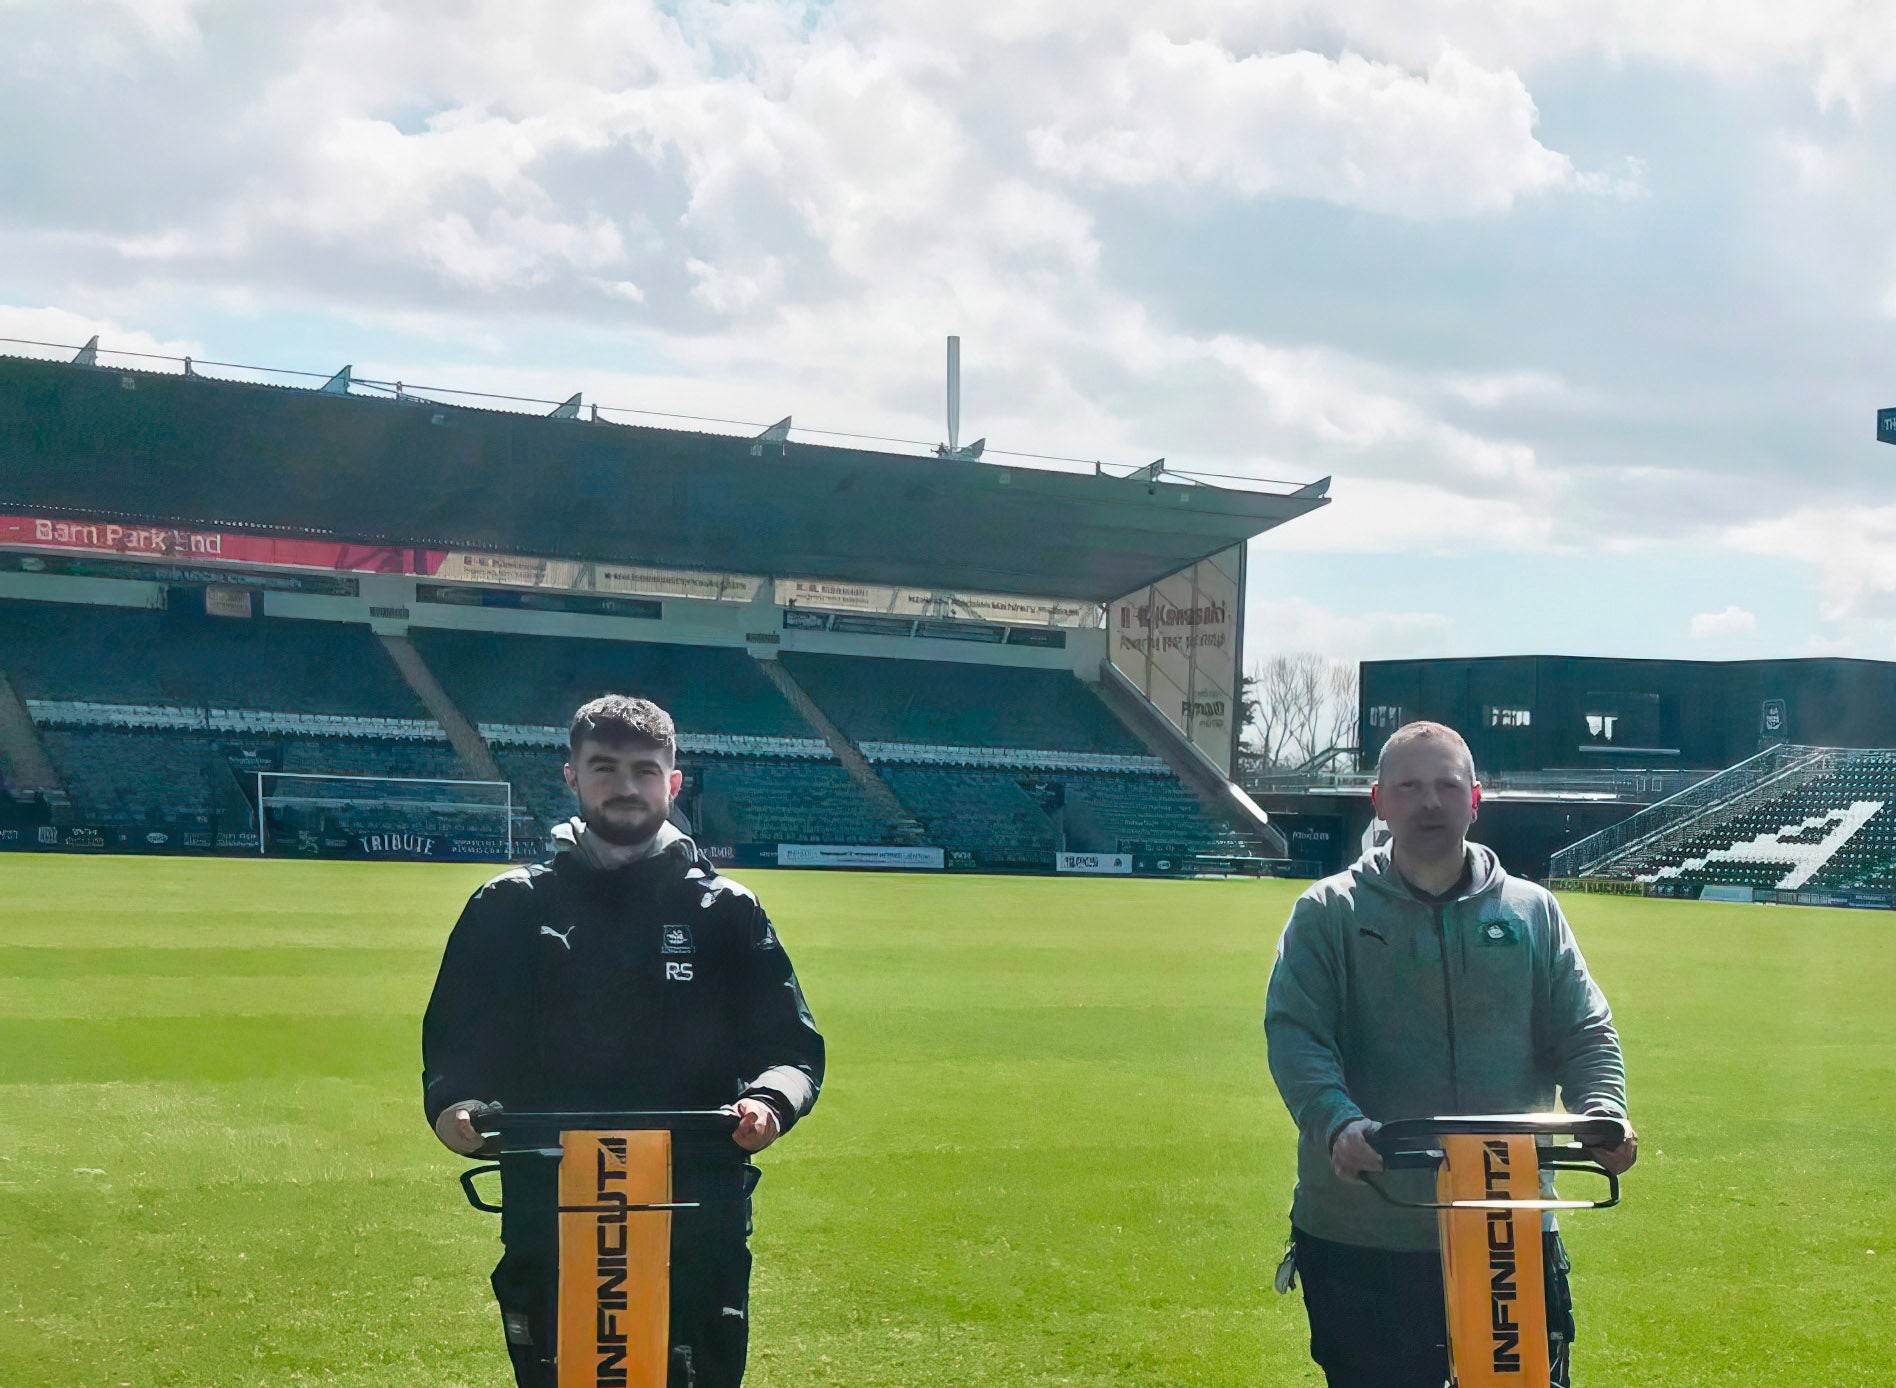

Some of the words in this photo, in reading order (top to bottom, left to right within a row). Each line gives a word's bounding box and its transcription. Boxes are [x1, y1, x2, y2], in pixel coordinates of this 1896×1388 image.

[35, 518, 98, 545] Barn
[106, 524, 167, 551] Park
[359, 834, 436, 855] TRIBUTE
[665, 961, 694, 981] RS
[596, 1146, 628, 1388] INFINICUT
[1483, 1149, 1521, 1373] INFINICUT
